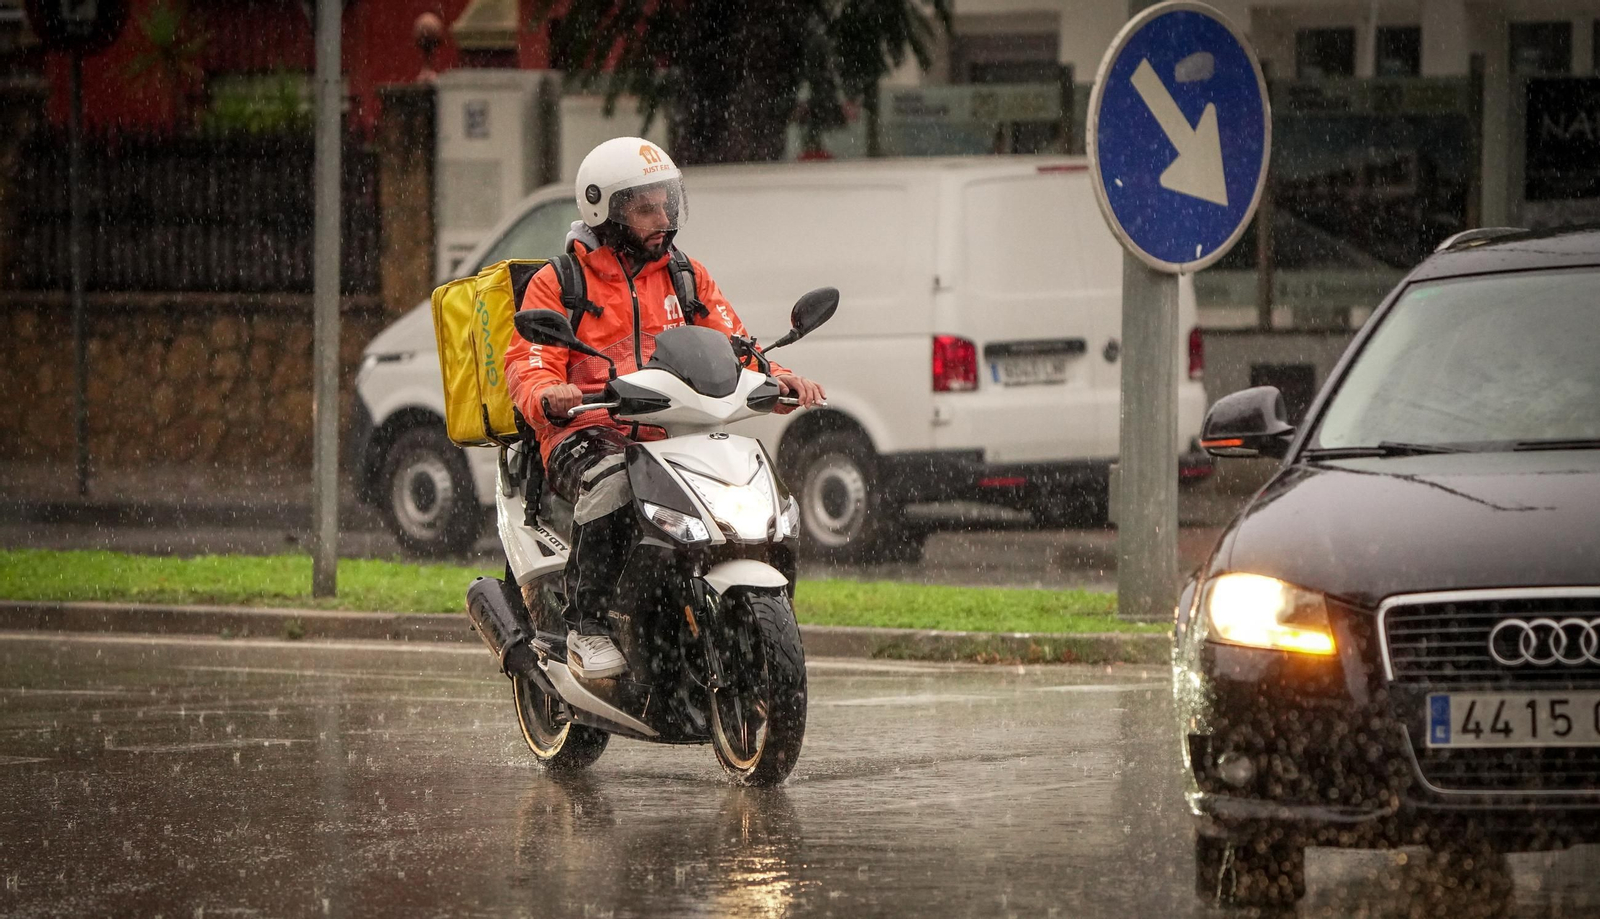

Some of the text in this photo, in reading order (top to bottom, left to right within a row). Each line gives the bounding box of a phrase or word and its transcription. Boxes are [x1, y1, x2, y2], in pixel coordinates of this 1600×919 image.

[643, 165, 659, 175] JUST
[716, 304, 733, 328] EAT
[481, 310, 498, 387] Glovo
[1461, 700, 1573, 739] 4415
